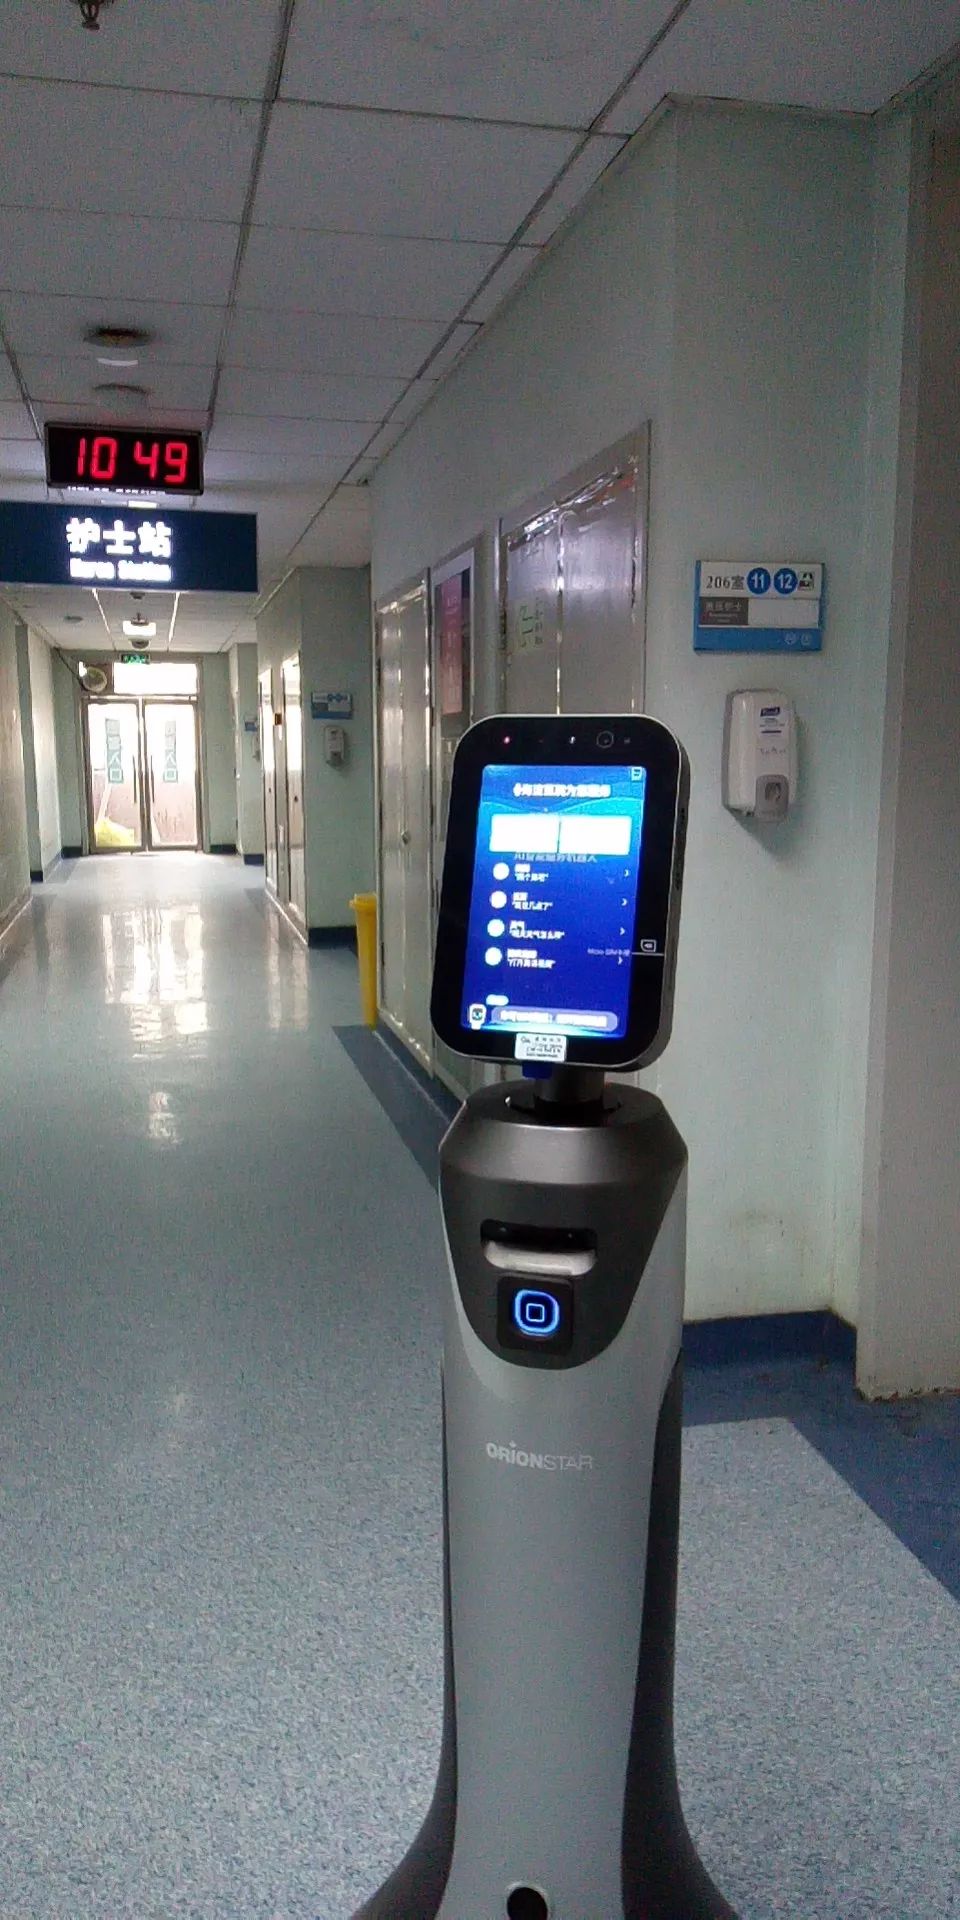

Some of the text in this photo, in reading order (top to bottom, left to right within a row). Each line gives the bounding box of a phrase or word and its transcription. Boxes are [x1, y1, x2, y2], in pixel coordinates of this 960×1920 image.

[66, 518, 172, 558] 护士站
[706, 573, 793, 591] 206室 11 12
